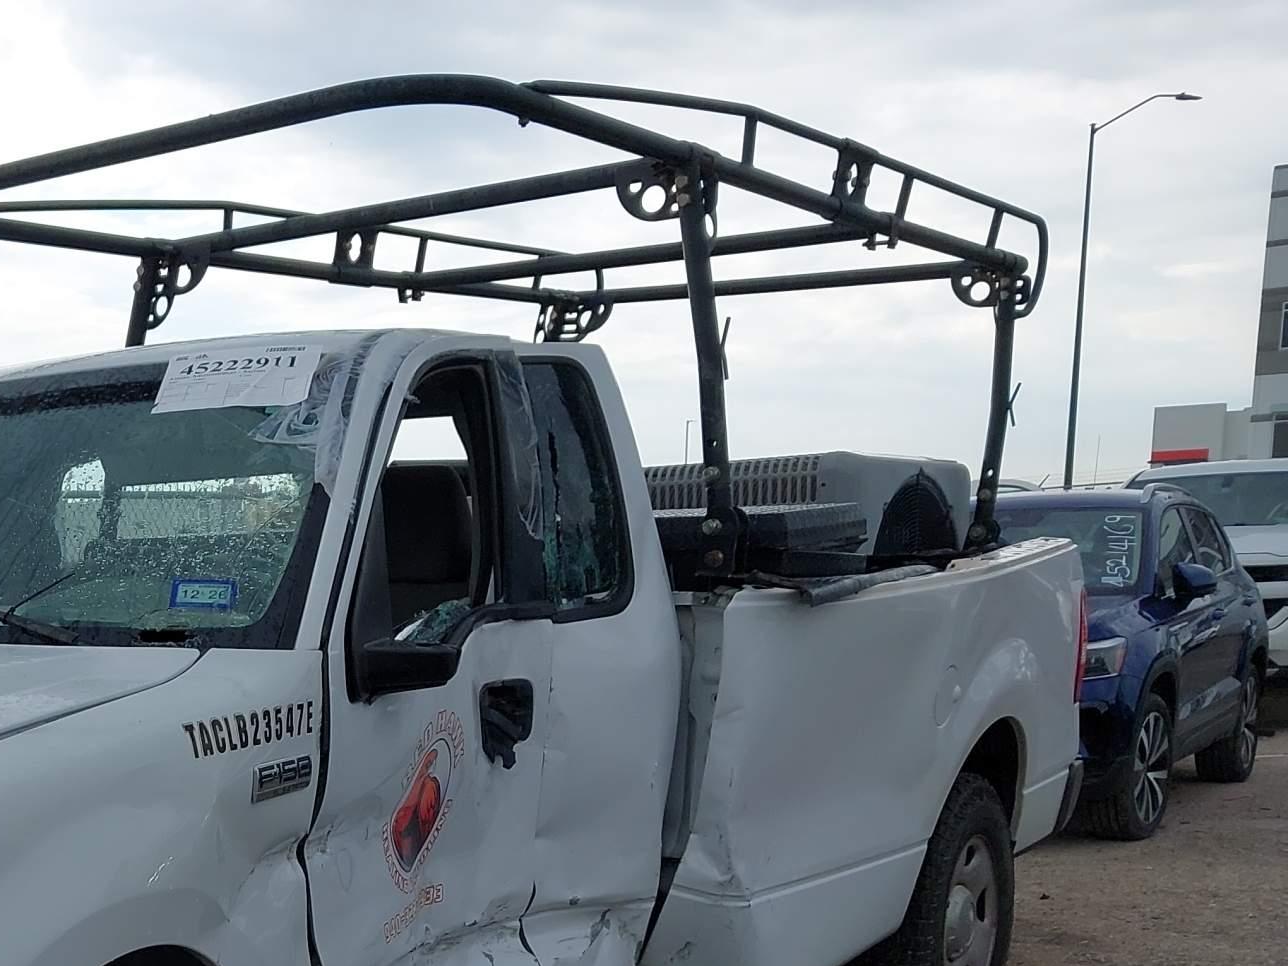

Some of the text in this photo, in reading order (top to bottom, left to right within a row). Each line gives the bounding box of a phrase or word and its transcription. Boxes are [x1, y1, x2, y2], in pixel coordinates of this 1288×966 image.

[179, 355, 297, 375] 45222911
[182, 589, 227, 600] 12 26
[182, 701, 313, 759] TACLB23547E
